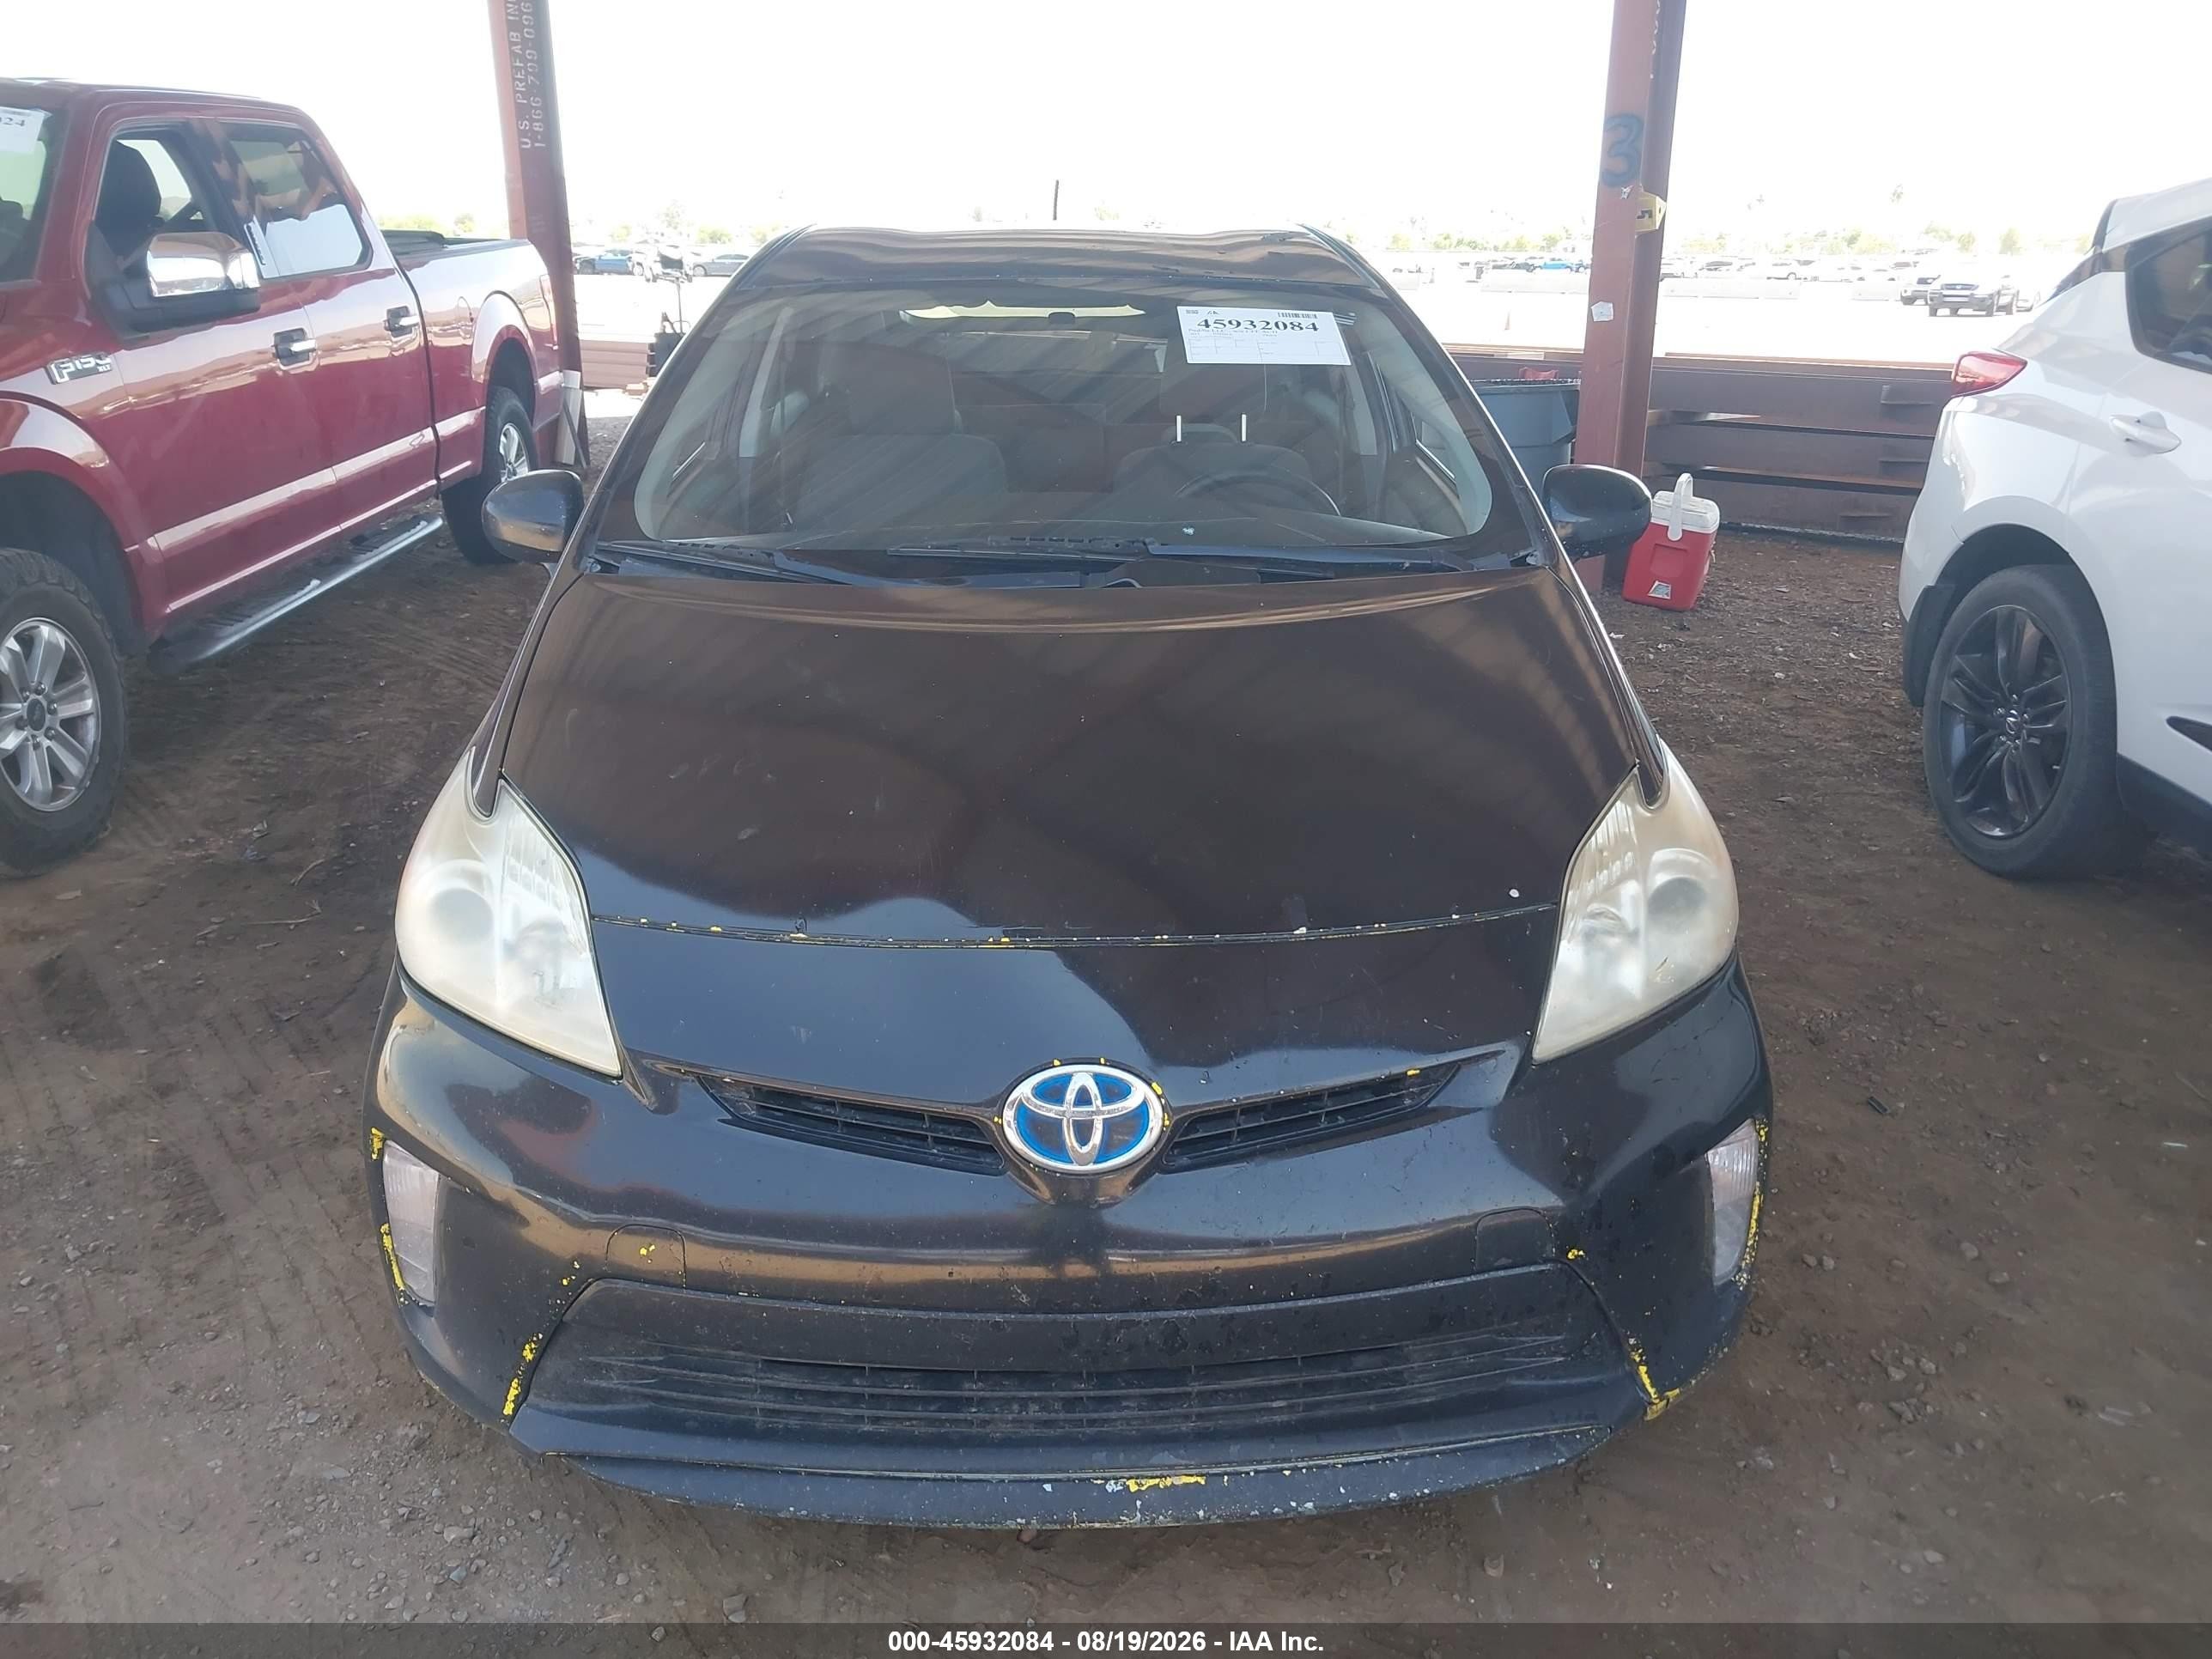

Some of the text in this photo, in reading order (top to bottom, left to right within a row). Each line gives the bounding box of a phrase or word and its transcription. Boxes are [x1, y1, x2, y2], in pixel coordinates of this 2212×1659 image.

[506, 0, 520, 21] IN
[509, 32, 527, 103] PREFAB
[1602, 112, 1644, 186] 3
[1197, 318, 1320, 332] 45932084
